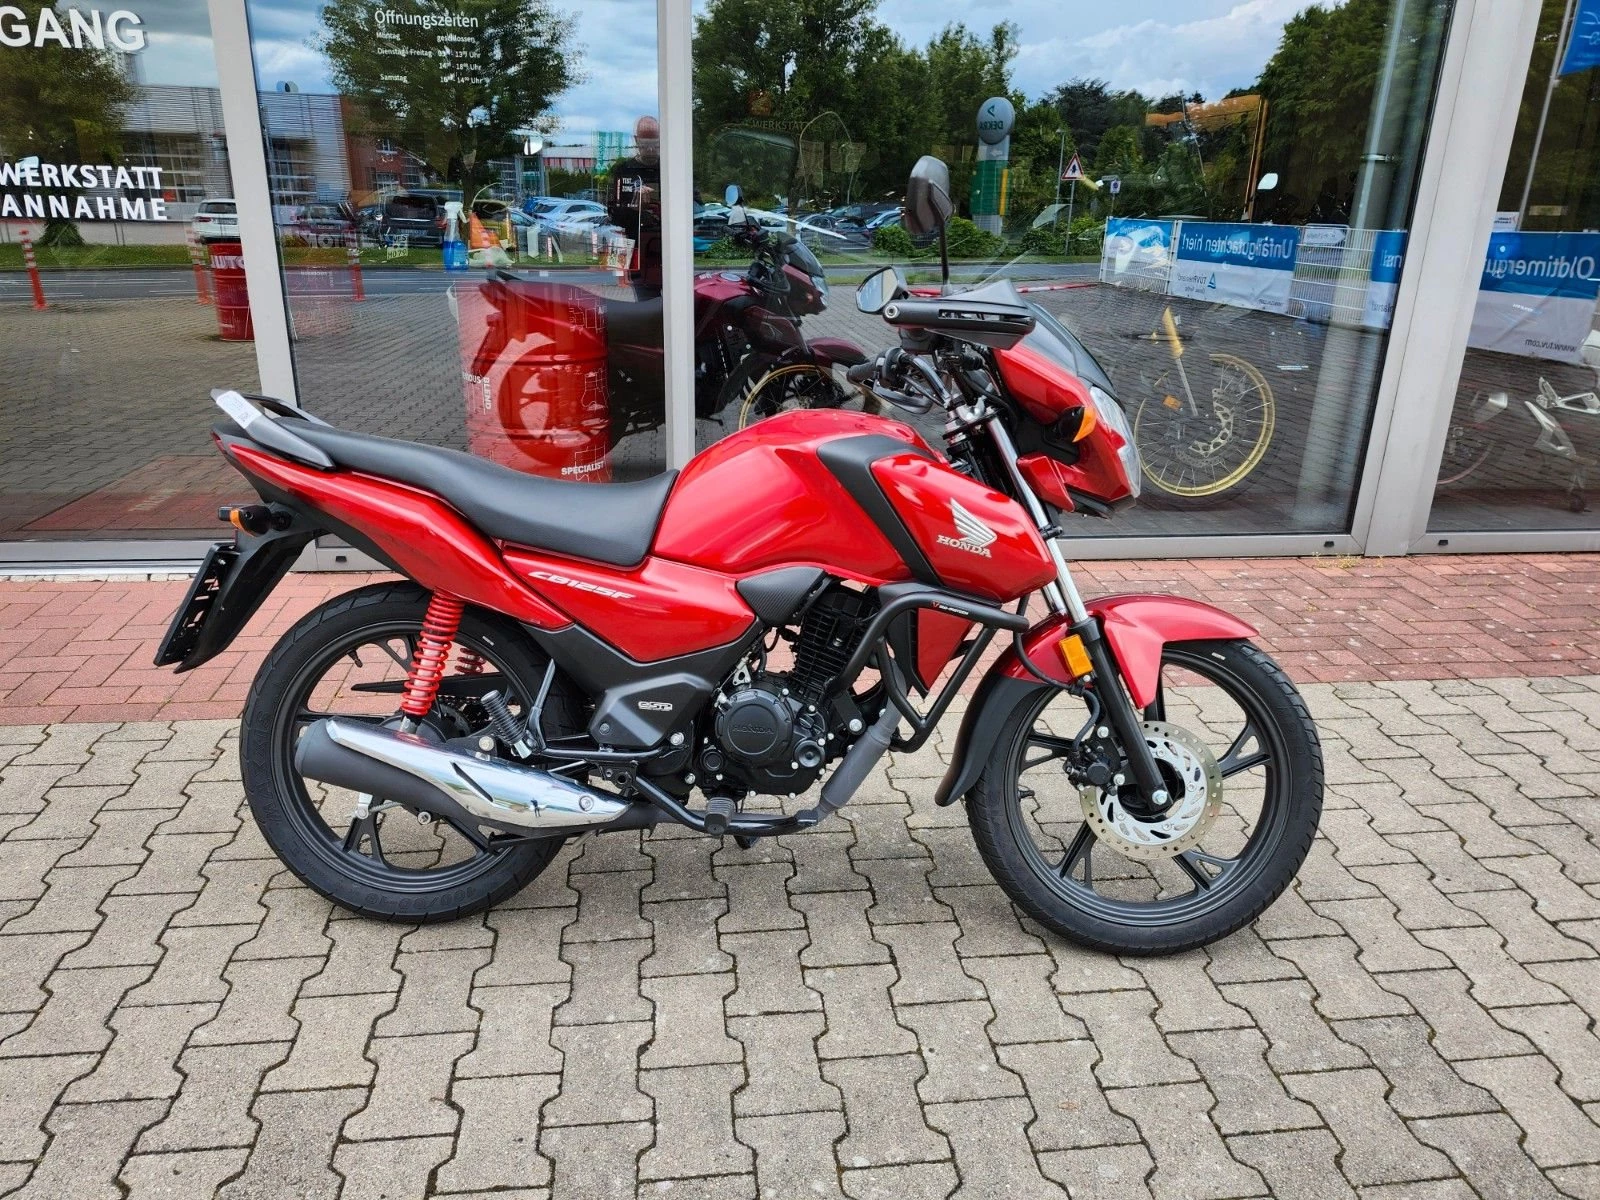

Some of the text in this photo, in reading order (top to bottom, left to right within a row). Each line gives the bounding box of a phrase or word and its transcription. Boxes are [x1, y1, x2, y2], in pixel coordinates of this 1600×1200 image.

[0, 6, 147, 51] GANG
[374, 8, 479, 30] Öffnungszeiten
[469, 50, 481, 59] Uhr
[469, 63, 482, 71] Uhr
[0, 162, 163, 191] WERKSTATT
[1, 194, 168, 220] ANNAHME
[561, 460, 605, 476] SPECIALIST
[936, 534, 992, 559] HONDA
[528, 570, 637, 599] CB125F
[731, 723, 775, 735] HONDA
